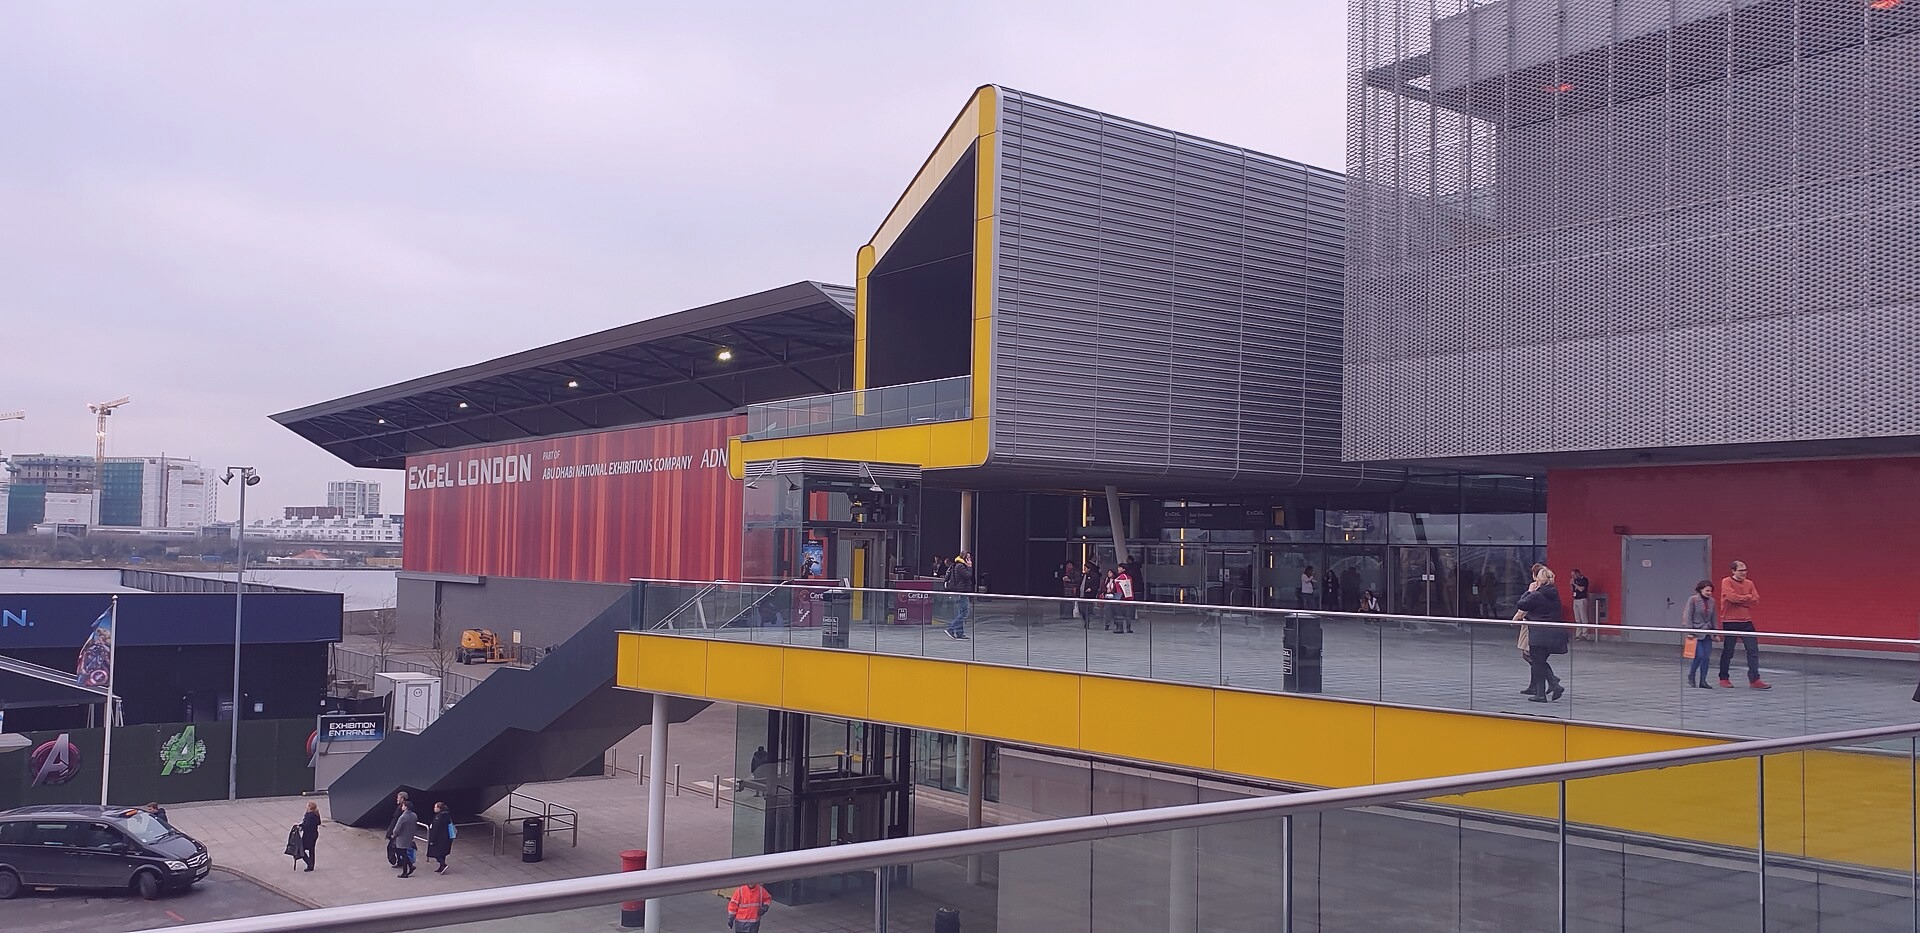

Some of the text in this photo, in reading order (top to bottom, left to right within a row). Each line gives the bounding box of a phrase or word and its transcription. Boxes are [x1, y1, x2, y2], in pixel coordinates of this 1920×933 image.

[542, 450, 561, 460] PART OF
[458, 453, 532, 486] LONDON
[542, 455, 693, 480] ABU DHABI NATIONAL EXHIBITIONS COMPANY
[329, 722, 376, 730] EXHIBITION
[328, 729, 376, 737] ENTRANCE
